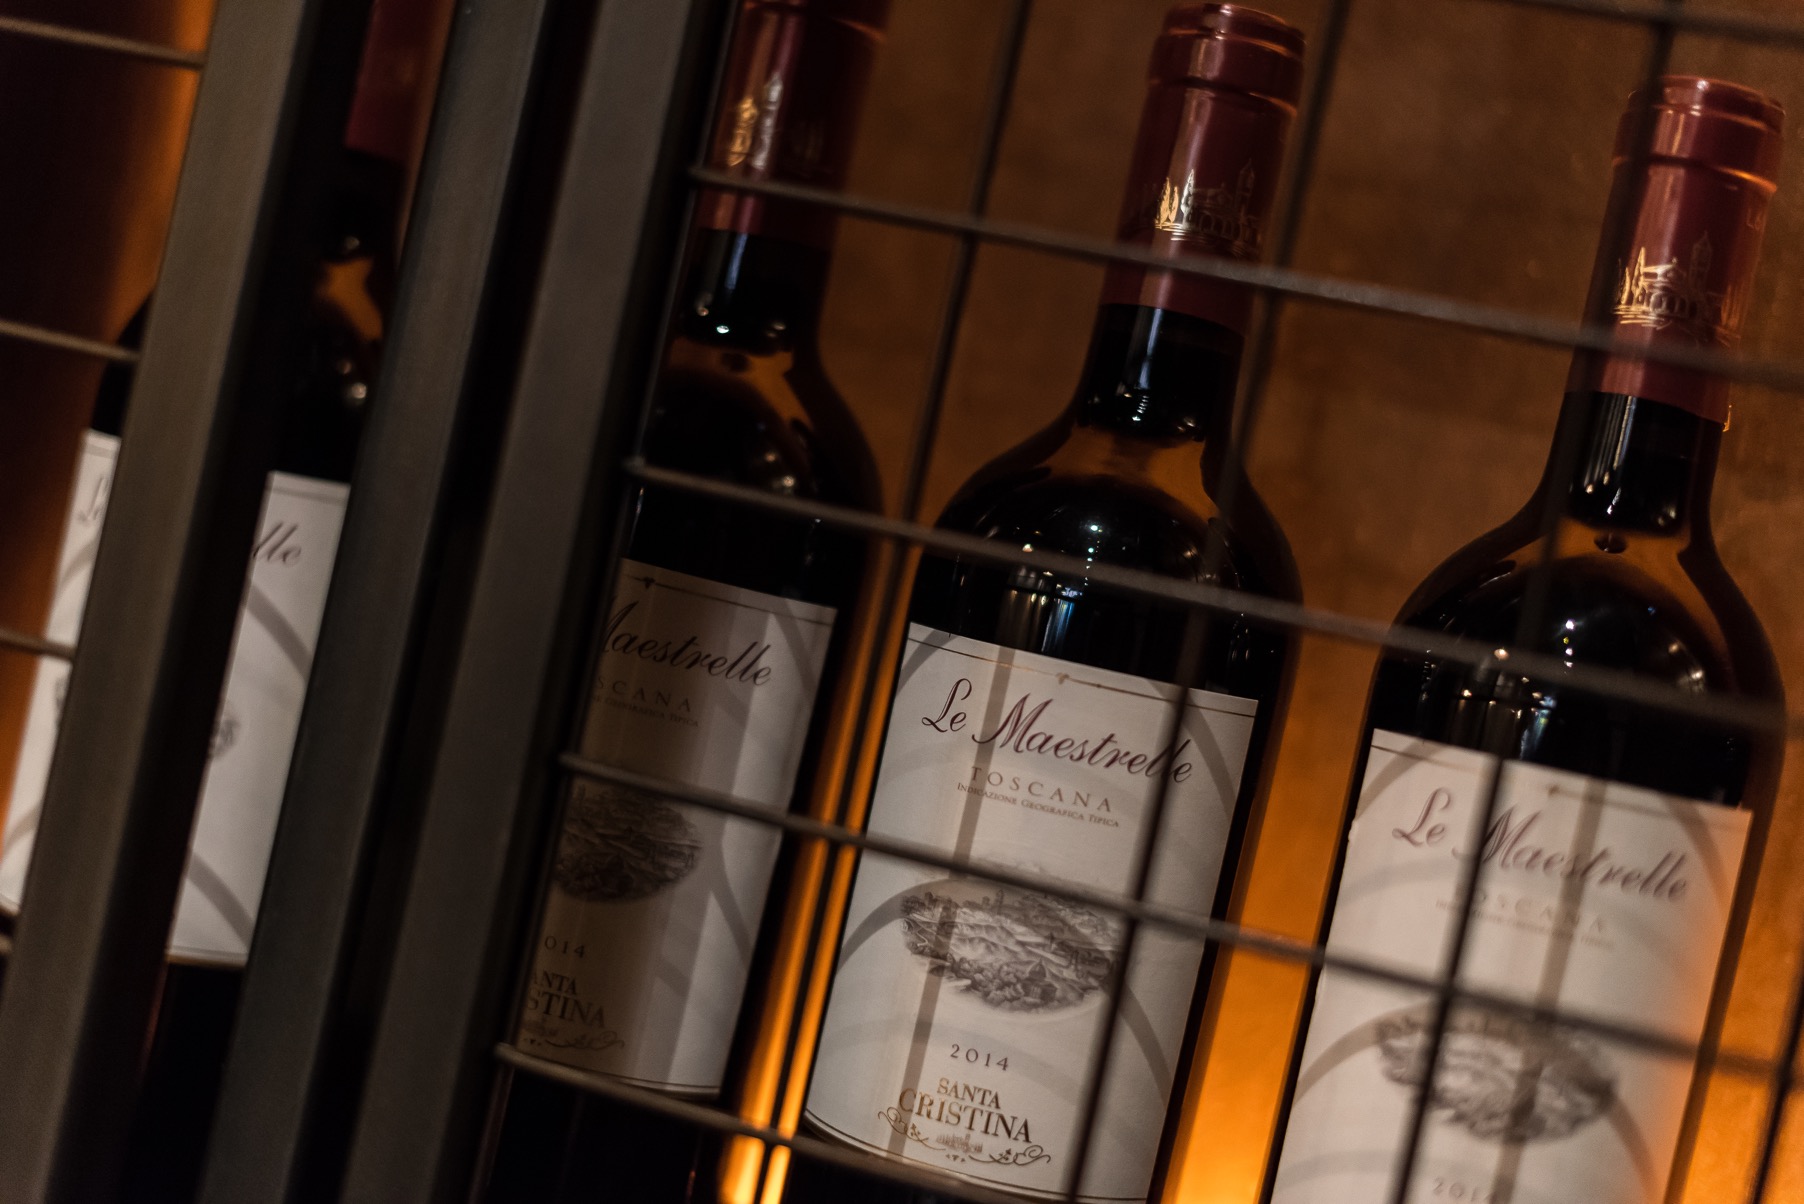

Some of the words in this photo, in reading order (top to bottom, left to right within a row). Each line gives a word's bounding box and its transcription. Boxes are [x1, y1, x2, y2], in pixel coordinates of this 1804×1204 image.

[597, 676, 692, 713] SCANA
[921, 678, 972, 733] Le
[957, 782, 1018, 805] INDICAZIONE
[1020, 799, 1085, 821] GEOGRAFICA
[1088, 814, 1120, 829] TIPICA
[970, 766, 1113, 813] TOSCANA
[1392, 787, 1451, 848] Le
[1451, 803, 1688, 902] Maestrelle
[544, 935, 586, 958] 014
[533, 970, 577, 995] NTA
[527, 987, 605, 1028] STINA
[949, 1043, 1010, 1072] 2014
[936, 1077, 1002, 1110] SANTA
[898, 1088, 1033, 1144] CRISTINA
